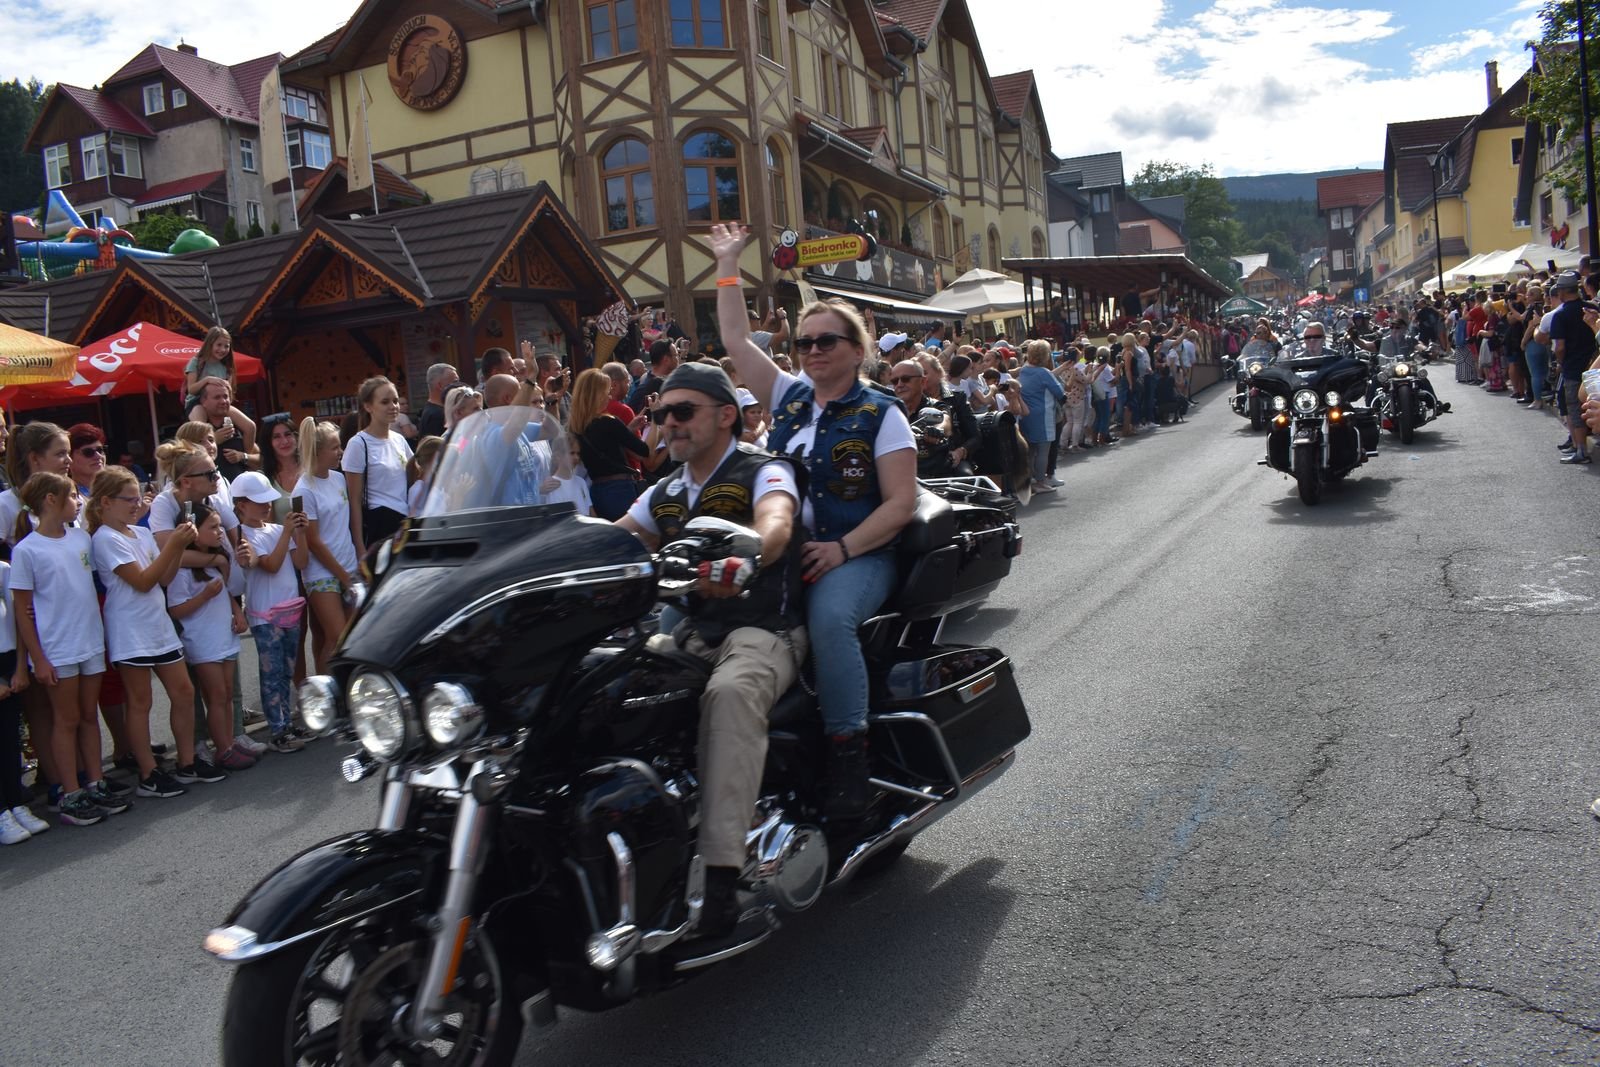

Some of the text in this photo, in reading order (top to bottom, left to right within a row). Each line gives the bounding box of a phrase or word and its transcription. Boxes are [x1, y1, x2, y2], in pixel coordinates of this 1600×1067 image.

[389, 15, 427, 57] SOWIDUCH
[801, 240, 857, 255] Biedronka
[843, 467, 865, 477] HOG
